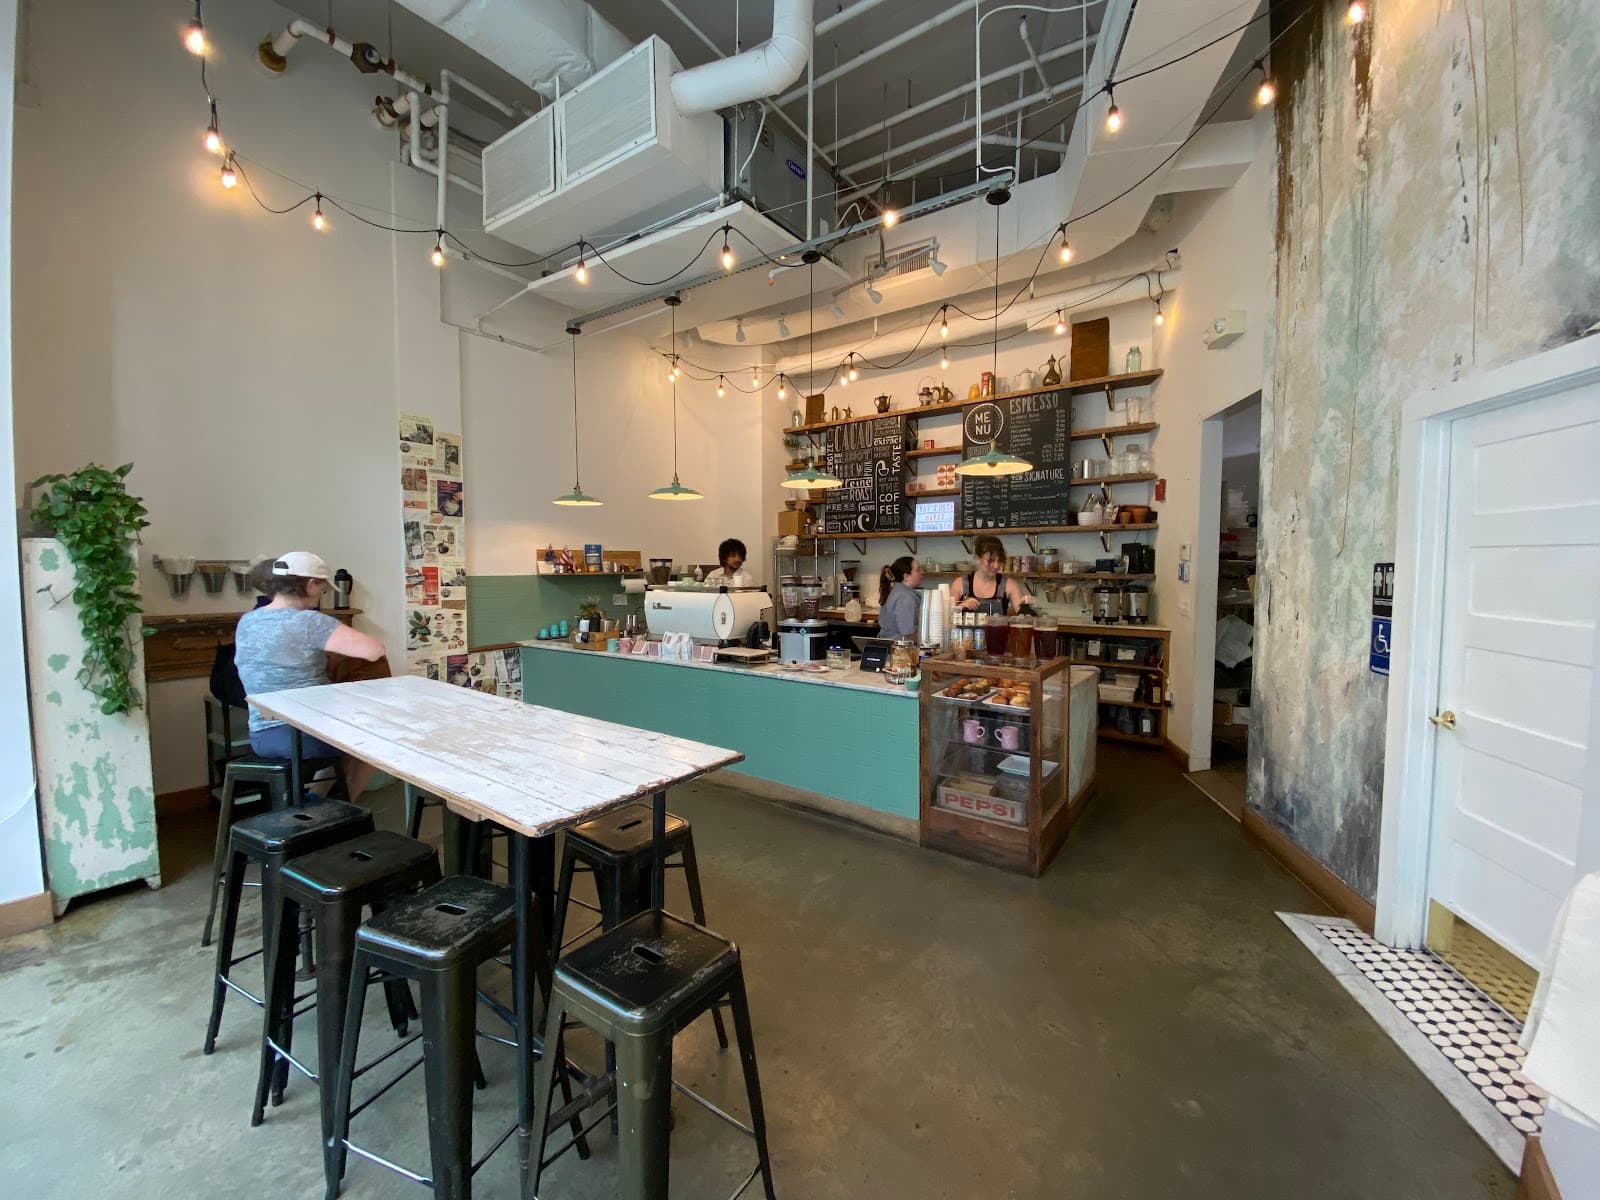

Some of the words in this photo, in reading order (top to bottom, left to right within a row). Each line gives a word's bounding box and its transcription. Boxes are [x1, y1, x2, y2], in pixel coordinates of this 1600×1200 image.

[1009, 393, 1059, 415] ESPRESSO
[975, 411, 991, 424] ME
[835, 420, 873, 452] CACAO
[975, 423, 991, 436] NU
[873, 435, 902, 446] extract
[826, 442, 834, 473] ERGIZE
[892, 443, 902, 475] TASTE
[1024, 468, 1065, 482] SIGNATURE
[849, 487, 873, 502] ROAST
[879, 492, 900, 502] COF
[826, 503, 856, 512] PRESS
[879, 503, 900, 515] FEE
[843, 520, 857, 532] SIP
[944, 793, 1016, 818] PEPSI
